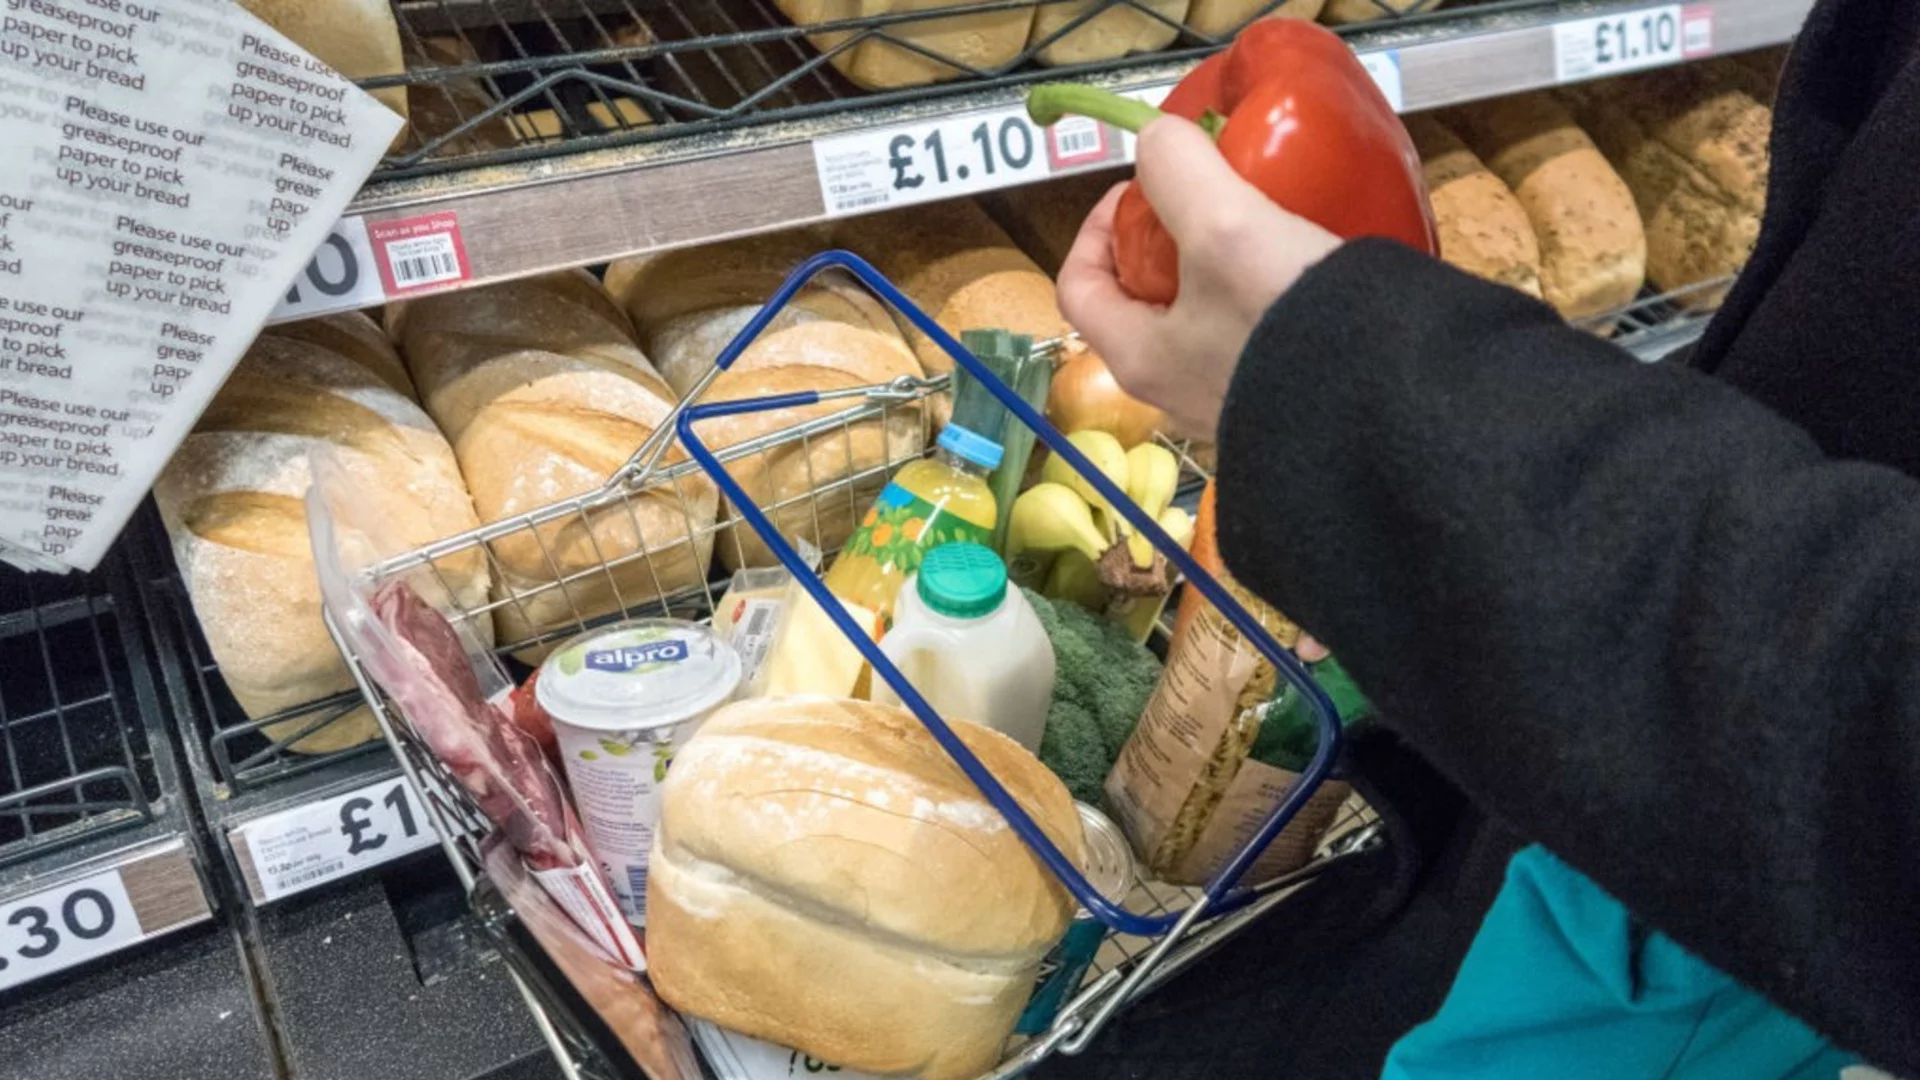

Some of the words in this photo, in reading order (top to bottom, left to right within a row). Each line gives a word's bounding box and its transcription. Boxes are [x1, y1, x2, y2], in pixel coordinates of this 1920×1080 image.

[8, 0, 137, 39] greaseproof
[125, 3, 160, 23] our
[3, 16, 67, 44] paper
[72, 34, 92, 51] to
[96, 43, 138, 66] pick
[242, 33, 300, 67] Please
[1596, 12, 1674, 62] £1.10
[1, 40, 29, 61] up
[33, 49, 81, 73] your
[86, 59, 146, 91] bread
[237, 60, 348, 102] greaseproof
[231, 82, 286, 107] paper
[290, 95, 308, 114] to
[310, 105, 346, 126] pick
[65, 95, 131, 128] Please
[135, 118, 169, 138] use
[172, 129, 206, 148] our
[228, 102, 252, 123] up
[255, 111, 296, 133] your
[300, 121, 351, 149] bread
[62, 122, 184, 163] greaseproof
[889, 117, 1033, 190] £1.10
[58, 144, 118, 168] paper
[122, 158, 141, 175] to
[145, 165, 184, 186] pick
[0, 194, 34, 212] our
[56, 166, 83, 186] up
[85, 174, 132, 194] your
[134, 180, 191, 208] bread
[116, 215, 177, 243] Please
[181, 233, 212, 251] use
[216, 240, 246, 258] our
[267, 216, 290, 235] up
[113, 240, 225, 273] greaseproof
[109, 260, 164, 282] paper
[168, 272, 186, 287] to
[189, 276, 225, 295] pick
[13, 300, 48, 316] use
[51, 307, 85, 322] our
[106, 281, 131, 298] up
[134, 287, 176, 303] your
[179, 291, 231, 314] bread
[2, 337, 22, 352] to
[26, 341, 67, 360] pick
[17, 356, 73, 379] bread
[1, 389, 61, 413] Please
[64, 401, 96, 417] use
[100, 407, 131, 422] our
[151, 382, 174, 397] up
[0, 411, 110, 437] greaseproof
[53, 437, 72, 451] to
[75, 441, 113, 458] pick
[20, 453, 64, 468] your
[66, 457, 119, 476] bread
[41, 541, 66, 555] up
[594, 645, 680, 668] alpro
